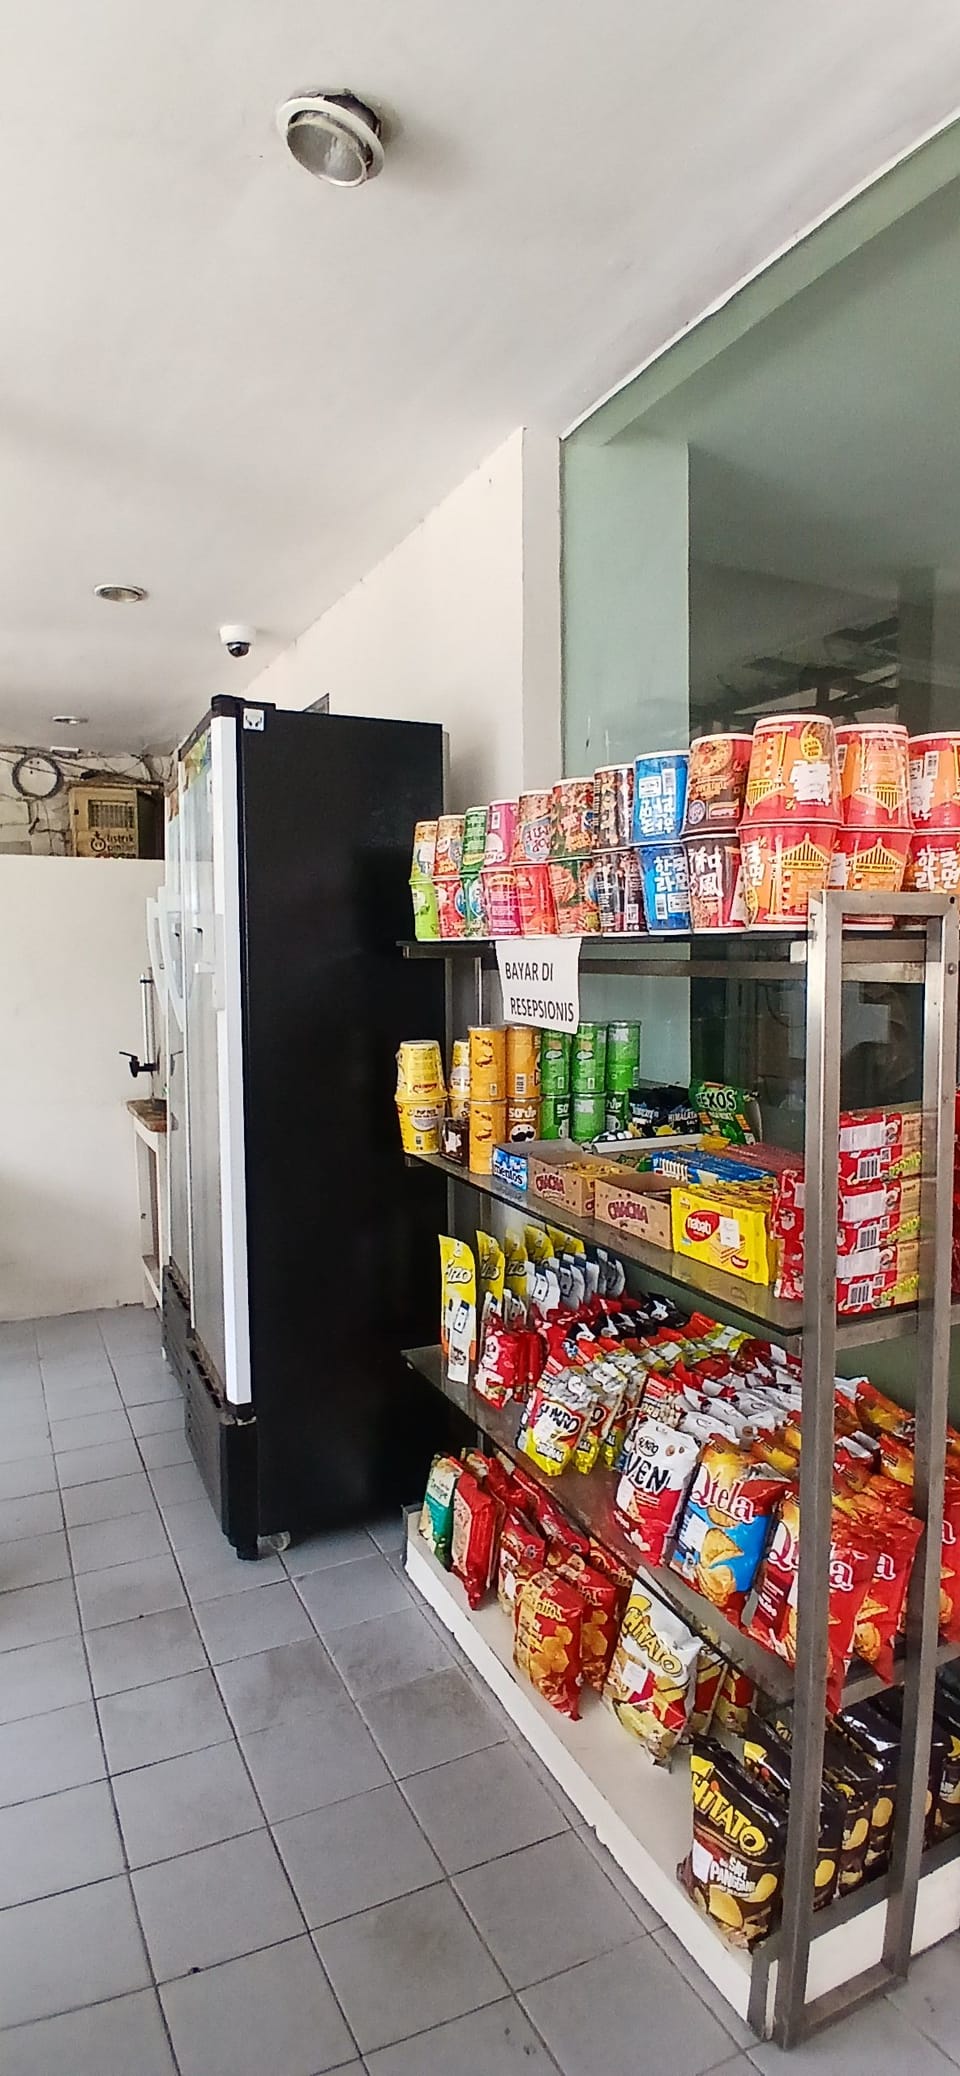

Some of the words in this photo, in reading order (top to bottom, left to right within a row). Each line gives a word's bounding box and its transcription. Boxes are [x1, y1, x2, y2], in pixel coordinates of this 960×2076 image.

[505, 962, 539, 980] BAYAR
[542, 962, 553, 981] DI
[510, 997, 574, 1021] RESEPSIONIS
